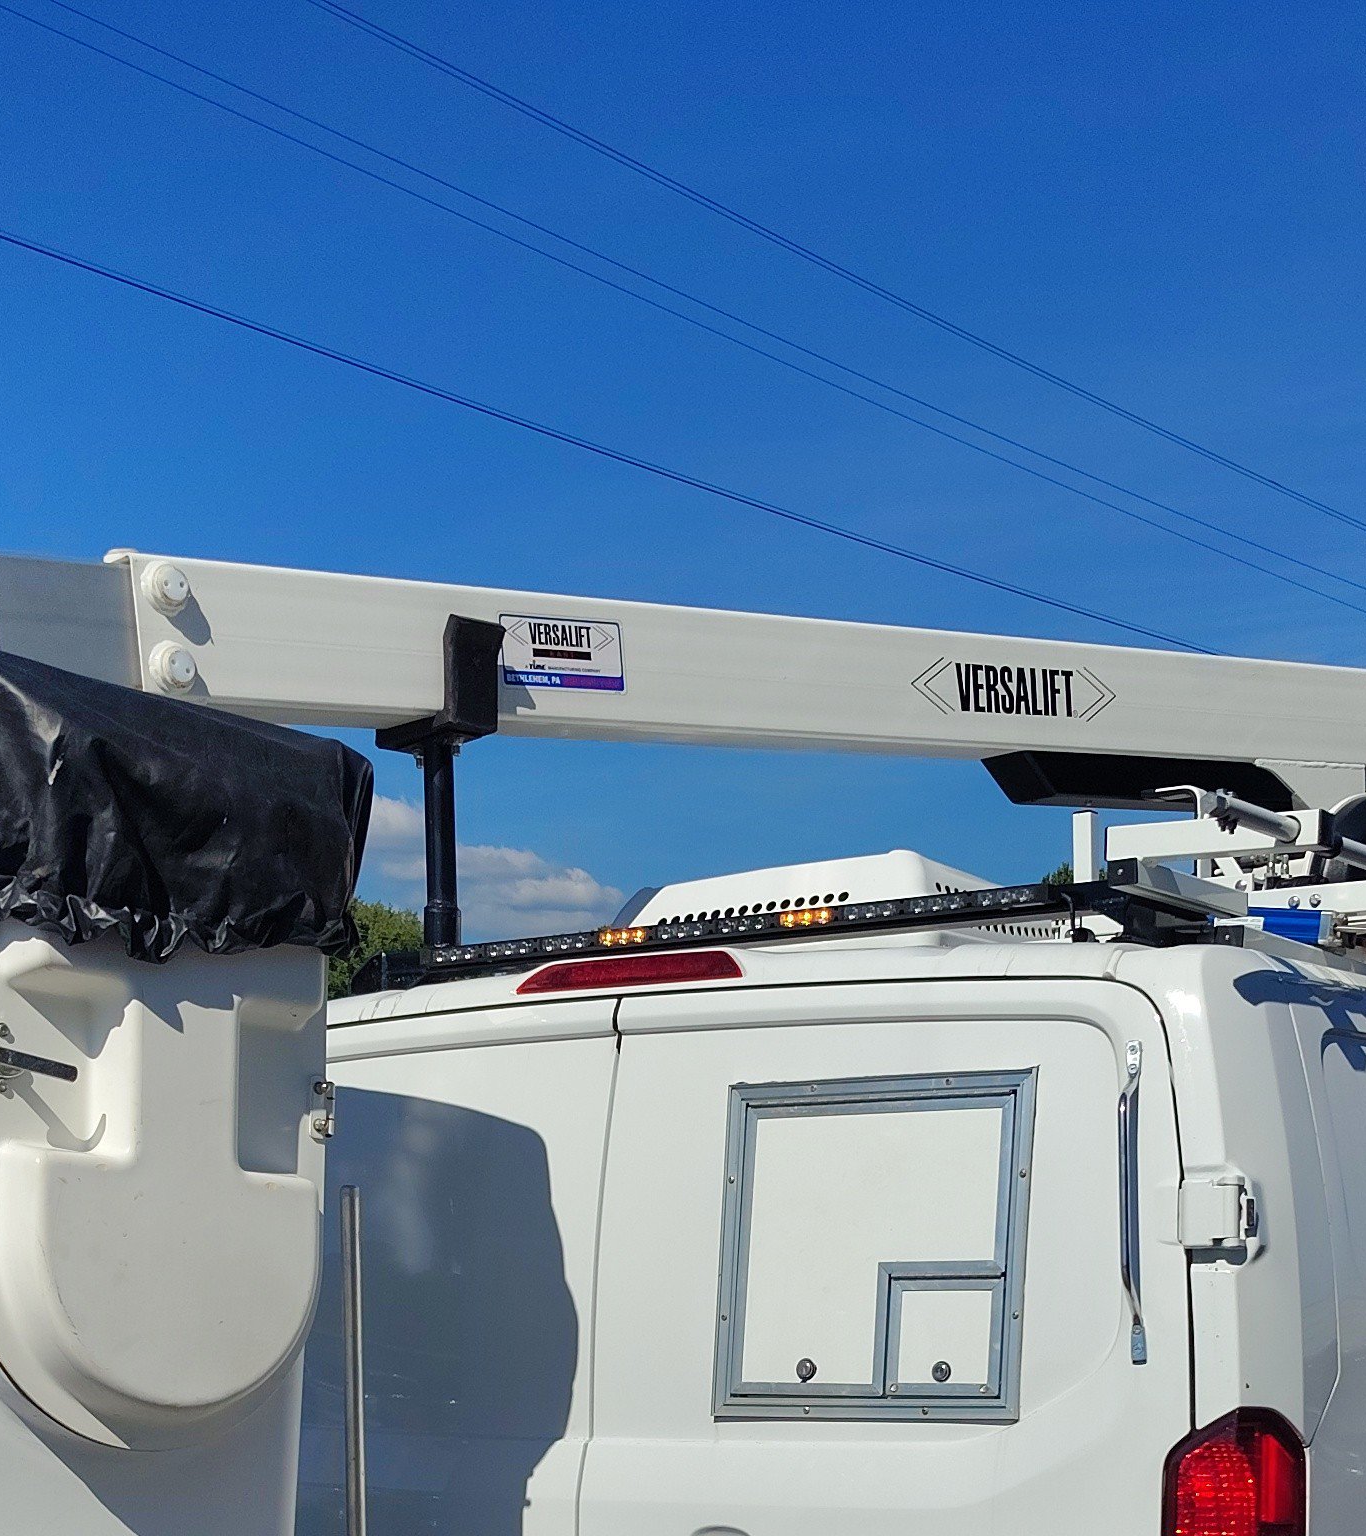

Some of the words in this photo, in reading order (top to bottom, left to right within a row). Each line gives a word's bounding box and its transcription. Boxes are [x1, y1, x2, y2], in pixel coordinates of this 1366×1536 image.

[527, 622, 591, 649] VERSALIFT
[506, 673, 551, 686] BETHLEHEM,
[551, 676, 561, 685] PA
[954, 662, 1074, 718] VERSALIFT
